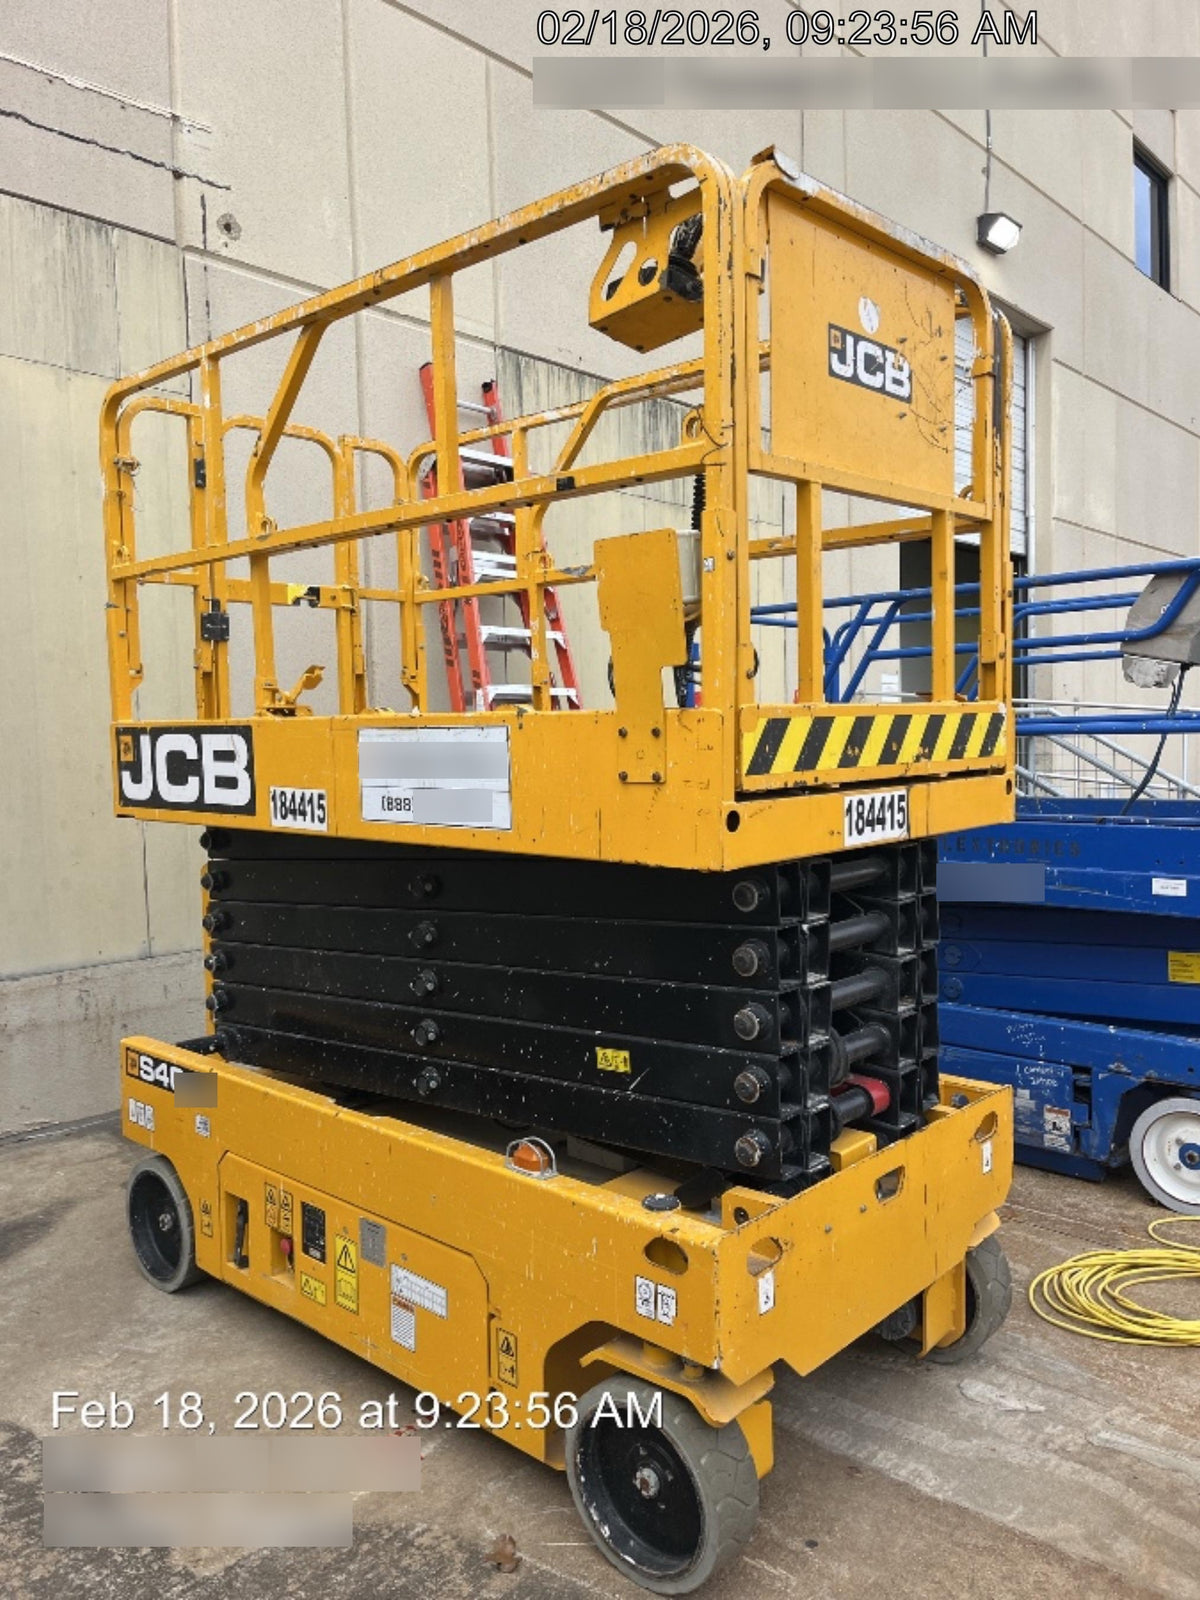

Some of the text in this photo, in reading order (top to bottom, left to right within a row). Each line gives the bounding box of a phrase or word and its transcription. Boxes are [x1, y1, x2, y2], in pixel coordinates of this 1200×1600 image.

[830, 333, 911, 399] JCB
[121, 733, 252, 806] JCB
[271, 788, 326, 824] 184415
[845, 794, 906, 837] 184415
